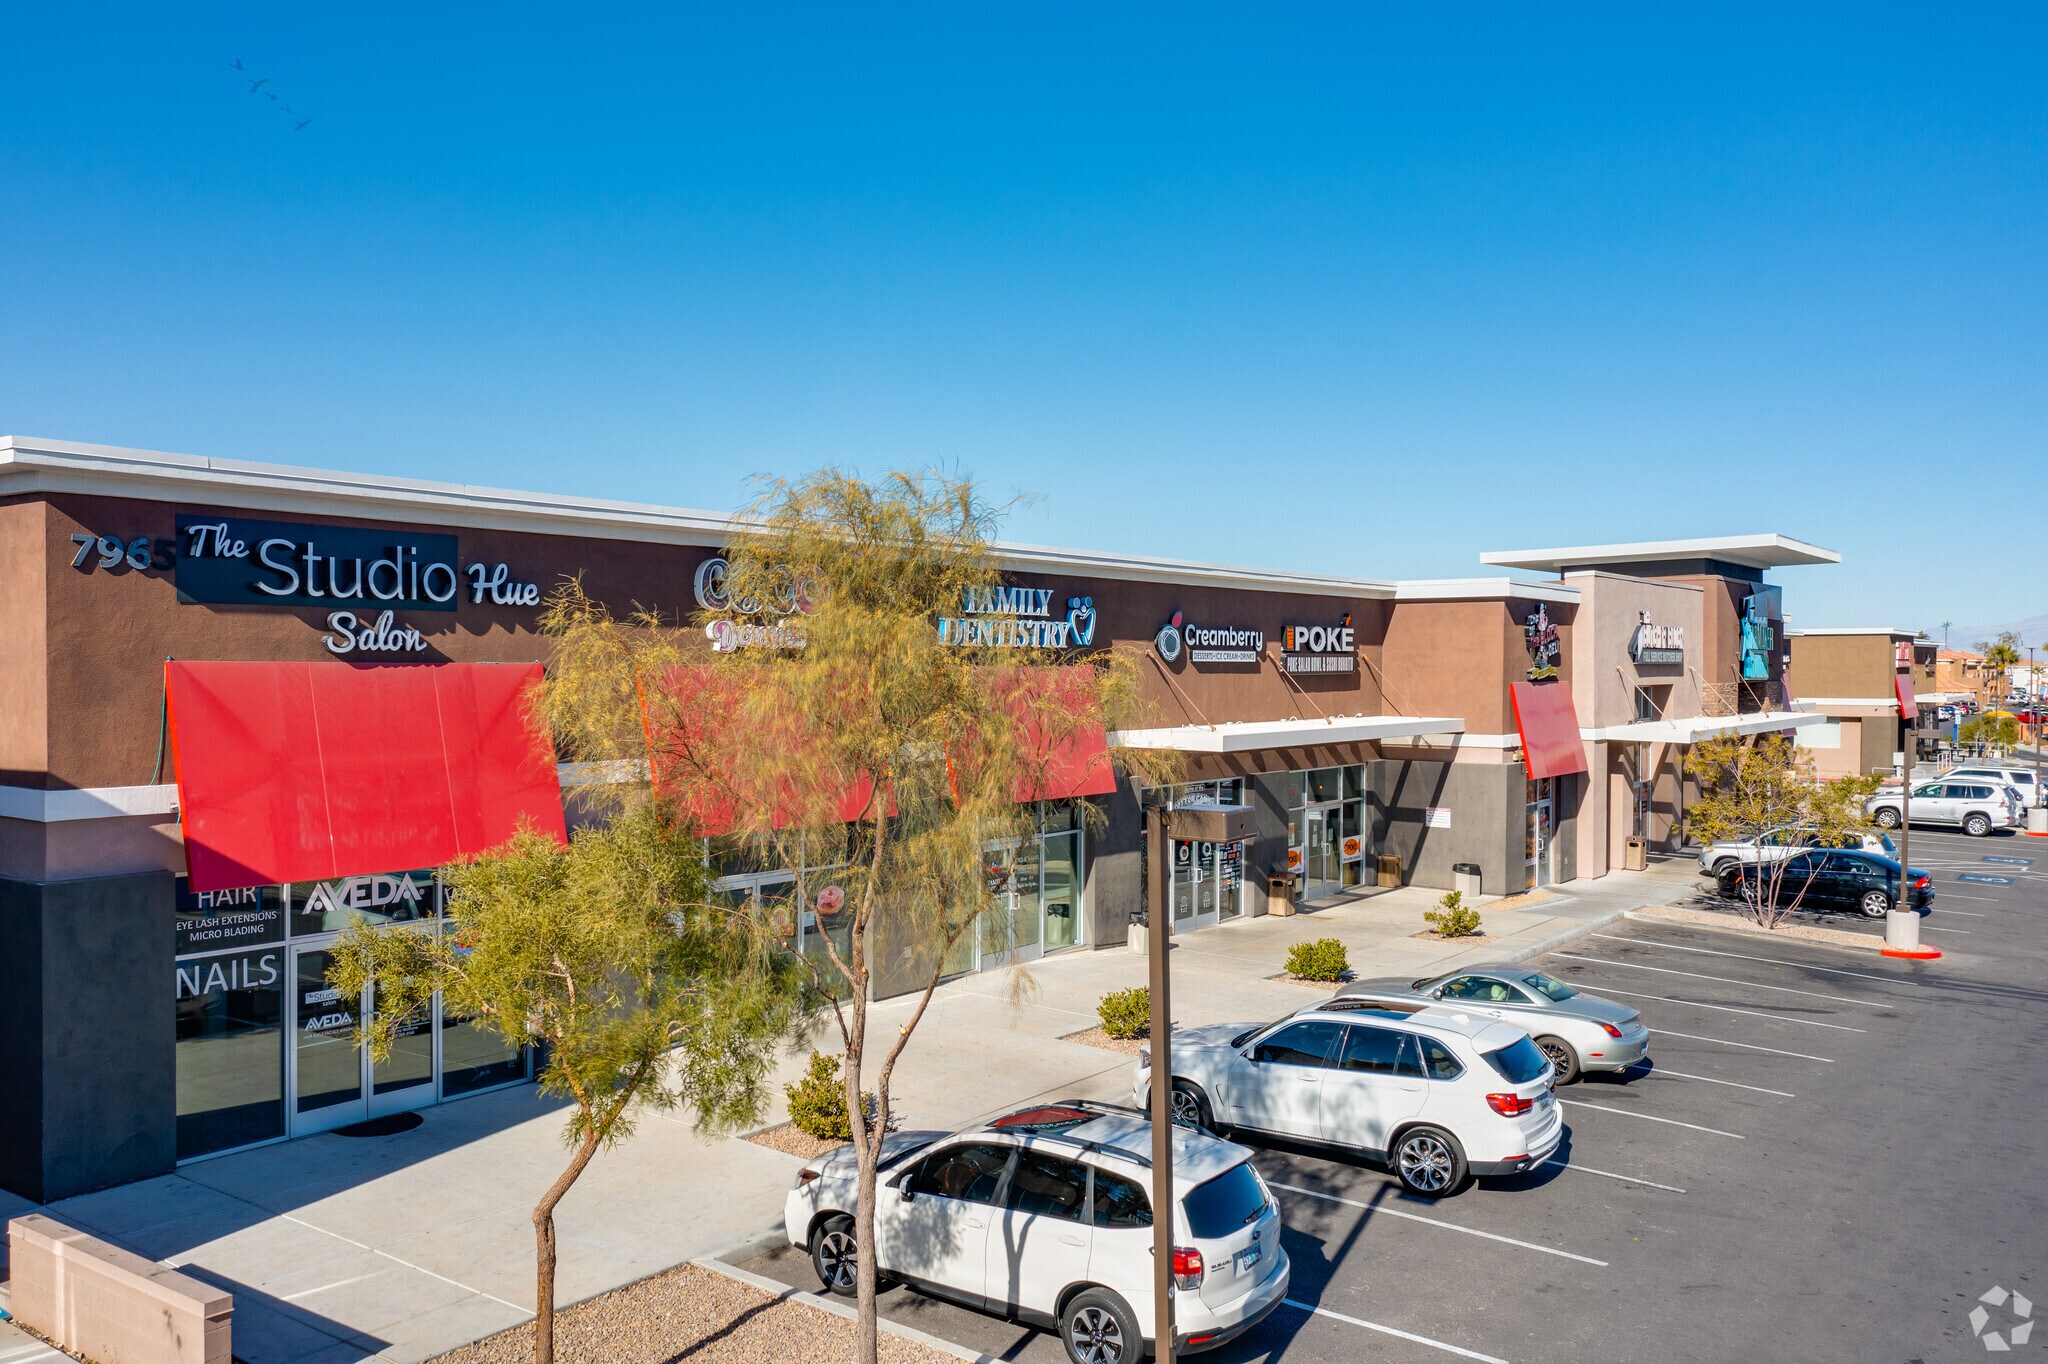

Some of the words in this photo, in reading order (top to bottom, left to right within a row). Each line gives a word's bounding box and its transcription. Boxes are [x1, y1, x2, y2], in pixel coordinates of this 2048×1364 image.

[70, 532, 175, 571] 7965
[187, 523, 250, 558] The
[255, 538, 457, 602] Studio
[464, 563, 540, 607] Hue
[963, 586, 1054, 616] FAMILY
[324, 610, 428, 654] Salon
[939, 617, 1070, 648] DENTISTRY
[1185, 623, 1263, 652] Creamberry
[198, 886, 257, 909] HAIR
[302, 872, 420, 915] AVEDA
[176, 920, 194, 931] EYE
[195, 917, 219, 929] LASH
[221, 911, 277, 926] EXTENSIONS
[189, 929, 222, 942] MICRO
[224, 924, 264, 938] BLADING
[176, 954, 277, 999] NAILS
[305, 1011, 352, 1031] AVEDA
